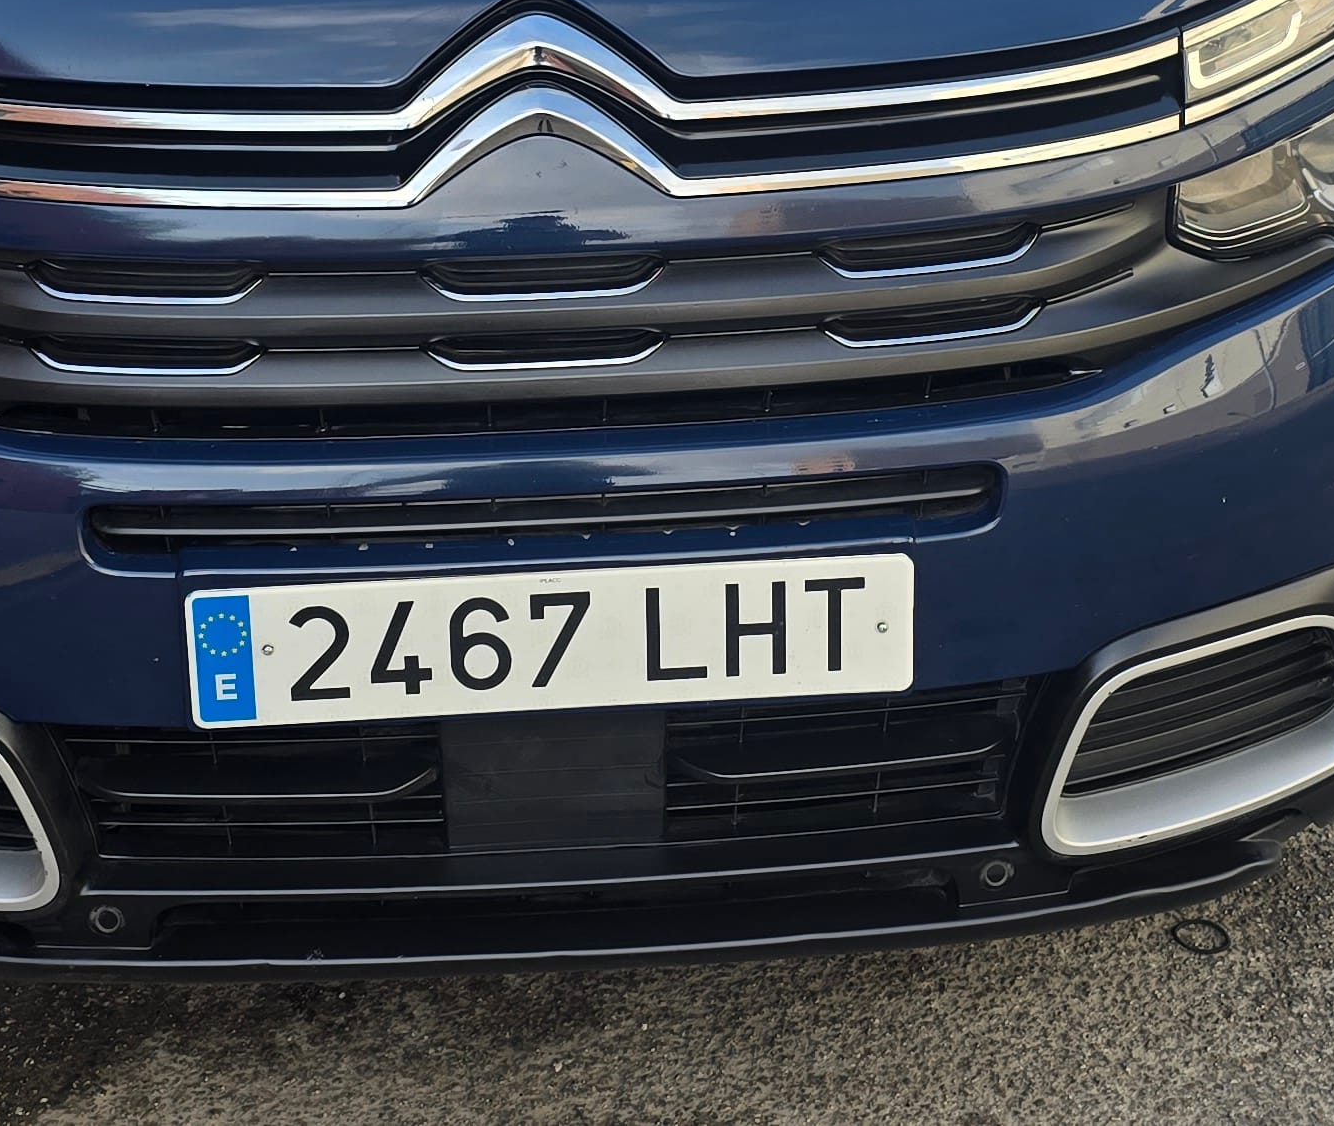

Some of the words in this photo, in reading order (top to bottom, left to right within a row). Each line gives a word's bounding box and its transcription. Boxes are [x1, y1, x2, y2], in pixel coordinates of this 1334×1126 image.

[288, 591, 591, 702] 2467
[645, 576, 866, 682] LHT
[214, 673, 238, 701] E
